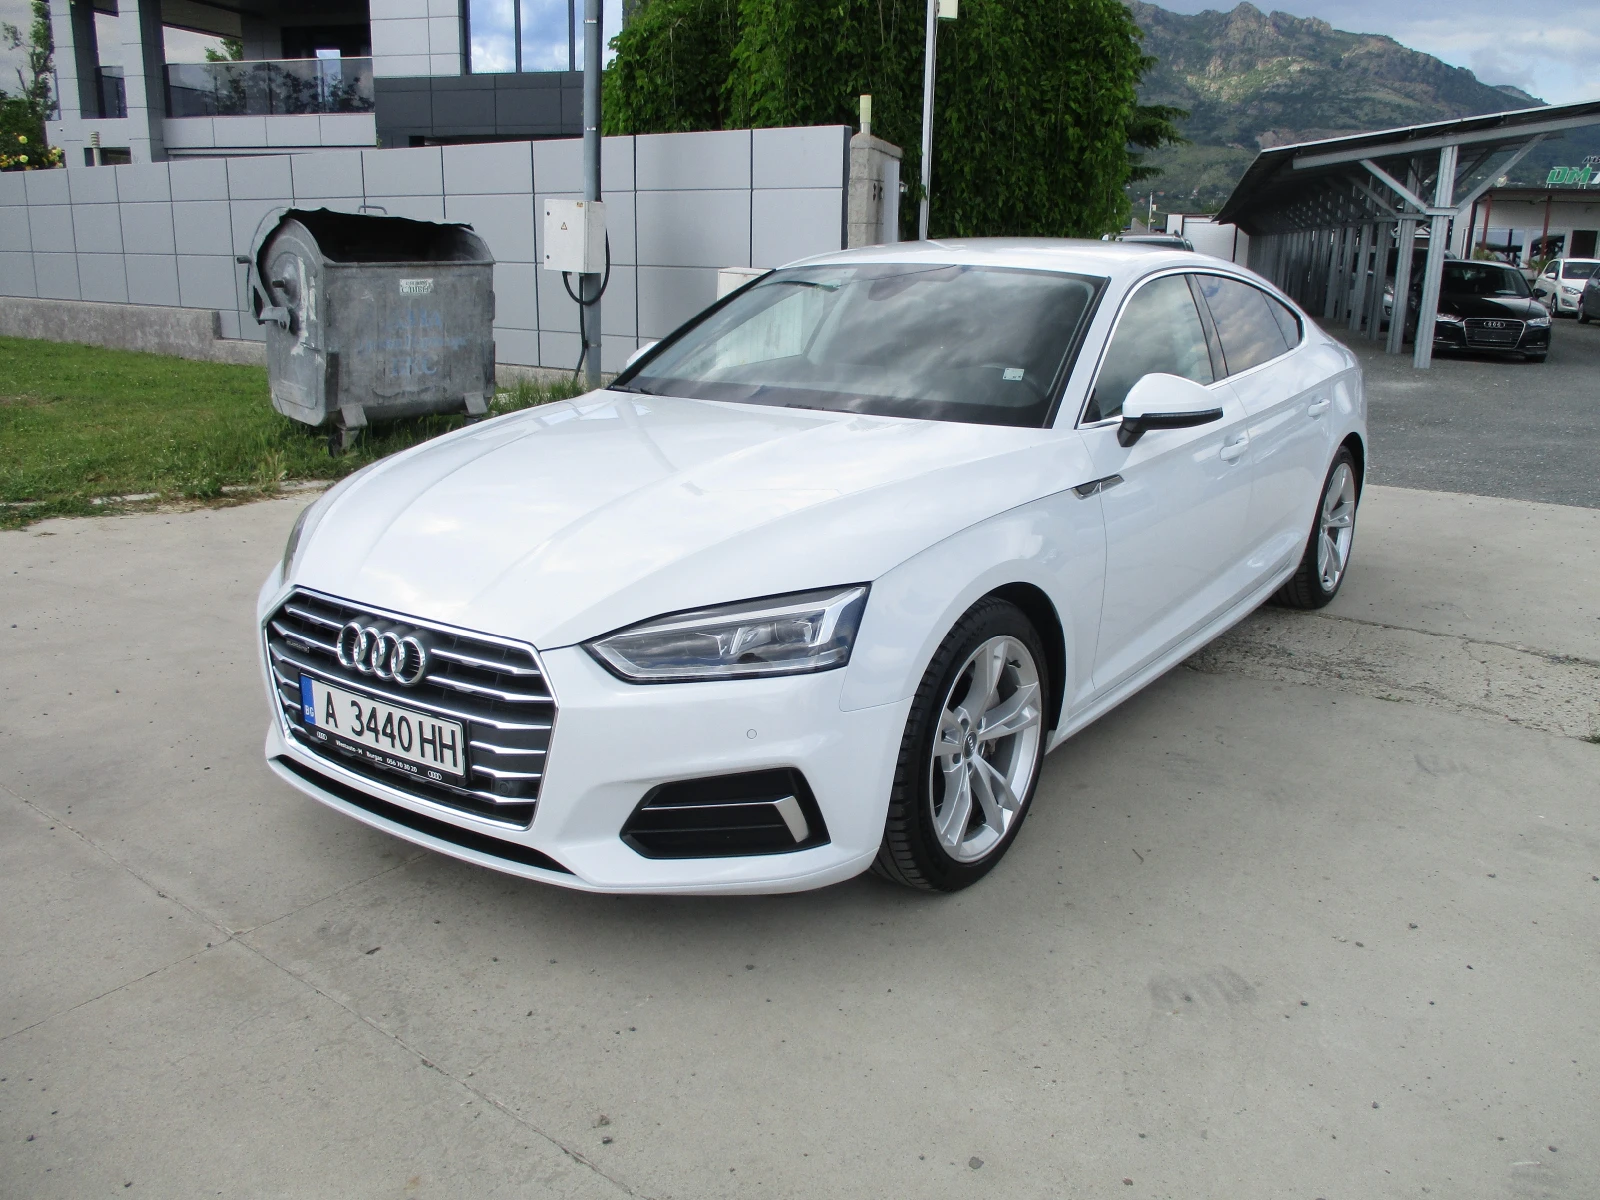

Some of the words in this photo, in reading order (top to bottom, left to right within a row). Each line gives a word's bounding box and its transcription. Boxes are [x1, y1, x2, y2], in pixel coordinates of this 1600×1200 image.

[305, 705, 315, 717] BG
[325, 691, 339, 729] A
[366, 751, 383, 762] Burgas
